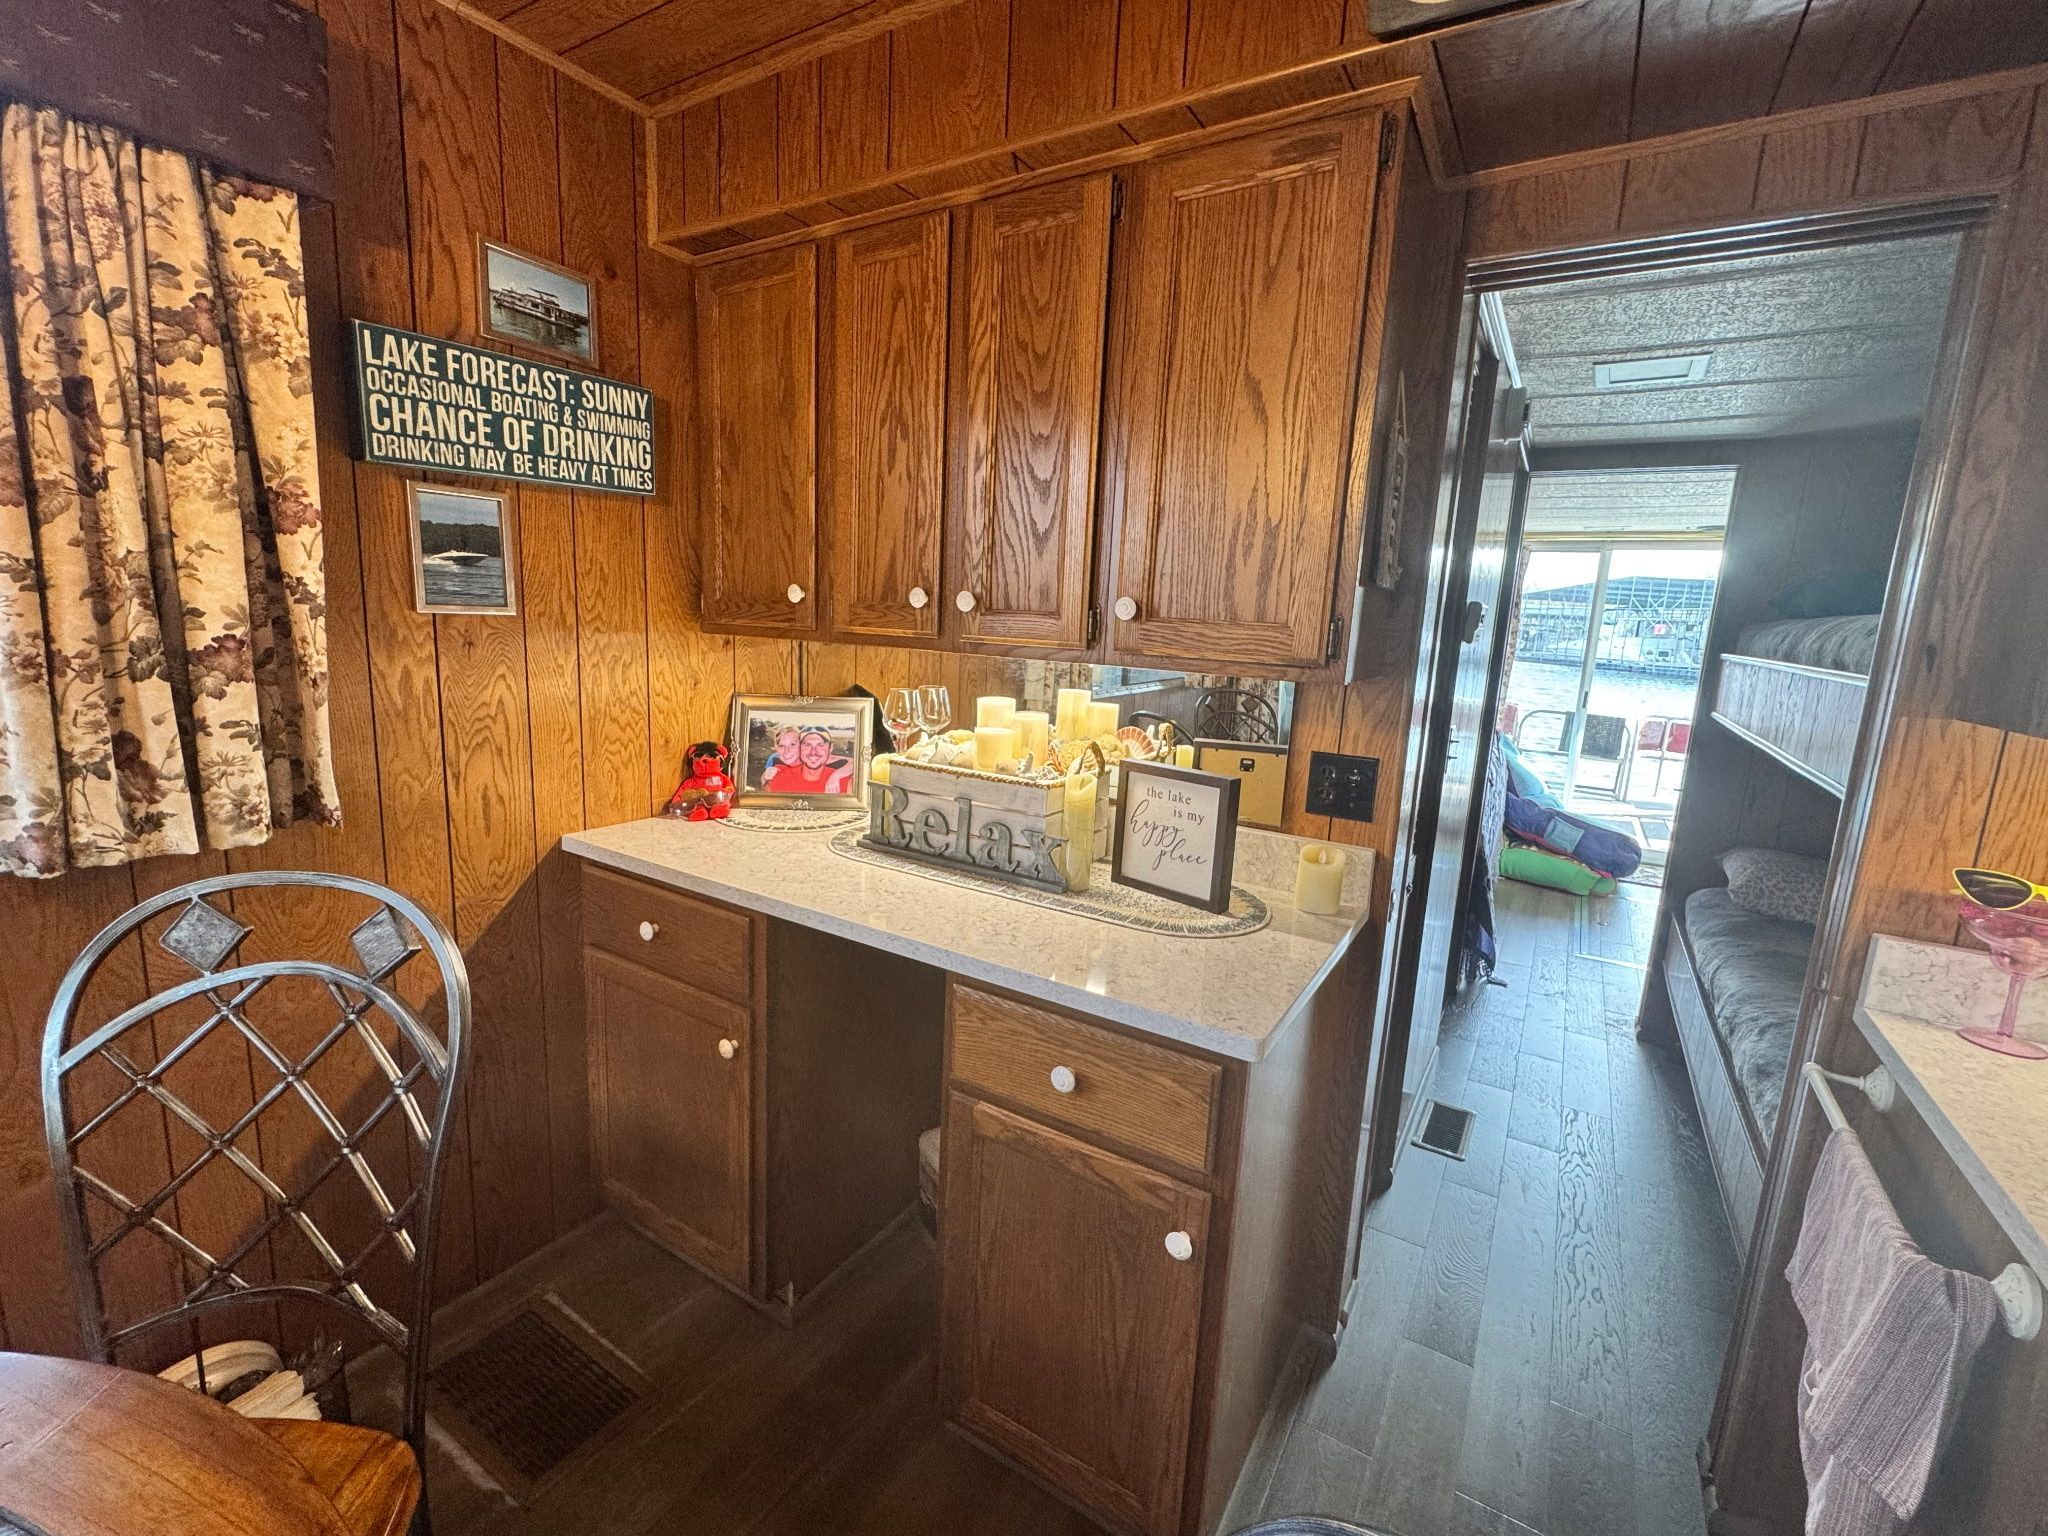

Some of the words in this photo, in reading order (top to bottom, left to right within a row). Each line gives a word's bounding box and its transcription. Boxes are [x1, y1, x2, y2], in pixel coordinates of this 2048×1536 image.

[363, 329, 439, 377] LAKE
[446, 349, 575, 404] FORECAST:
[582, 380, 648, 420] SUNNY
[366, 367, 486, 412] OCCASIONAL
[491, 391, 558, 420] BOATING
[563, 407, 572, 426] &
[577, 409, 650, 440] SWIMMING
[369, 393, 494, 447] CHANCE
[502, 416, 534, 452] OF
[543, 423, 651, 470] DRINKING
[372, 432, 465, 467] DRINKING
[470, 447, 506, 472] MAY
[512, 452, 533, 476] BE
[538, 456, 588, 482] HEAVY
[591, 466, 609, 484] AT
[612, 467, 652, 490] TIMES
[1129, 799, 1184, 848] happy
[1147, 786, 1163, 799] the
[1168, 789, 1191, 805] lake
[1173, 806, 1183, 819] is
[1187, 812, 1205, 825] my
[862, 781, 1069, 884] Relax
[1152, 839, 1208, 871] place
